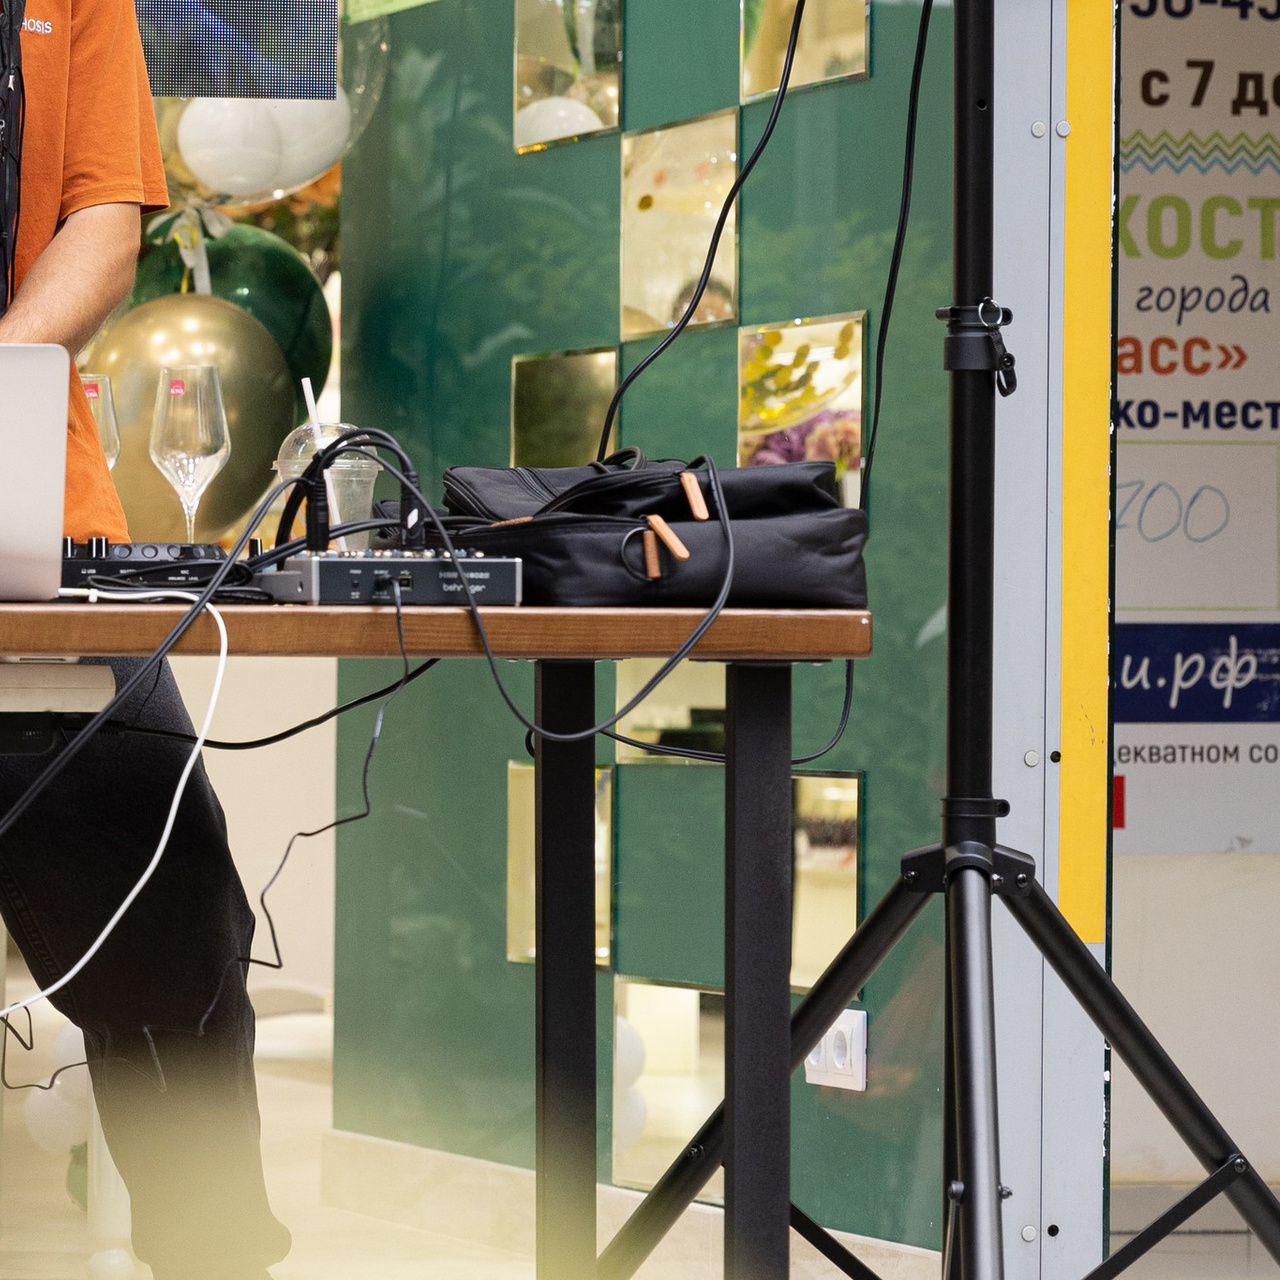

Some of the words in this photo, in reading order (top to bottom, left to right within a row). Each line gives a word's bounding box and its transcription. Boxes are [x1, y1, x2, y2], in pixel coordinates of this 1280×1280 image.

[1141, 70, 1170, 107] с
[1186, 59, 1215, 107] 7
[1136, 274, 1271, 326] города
